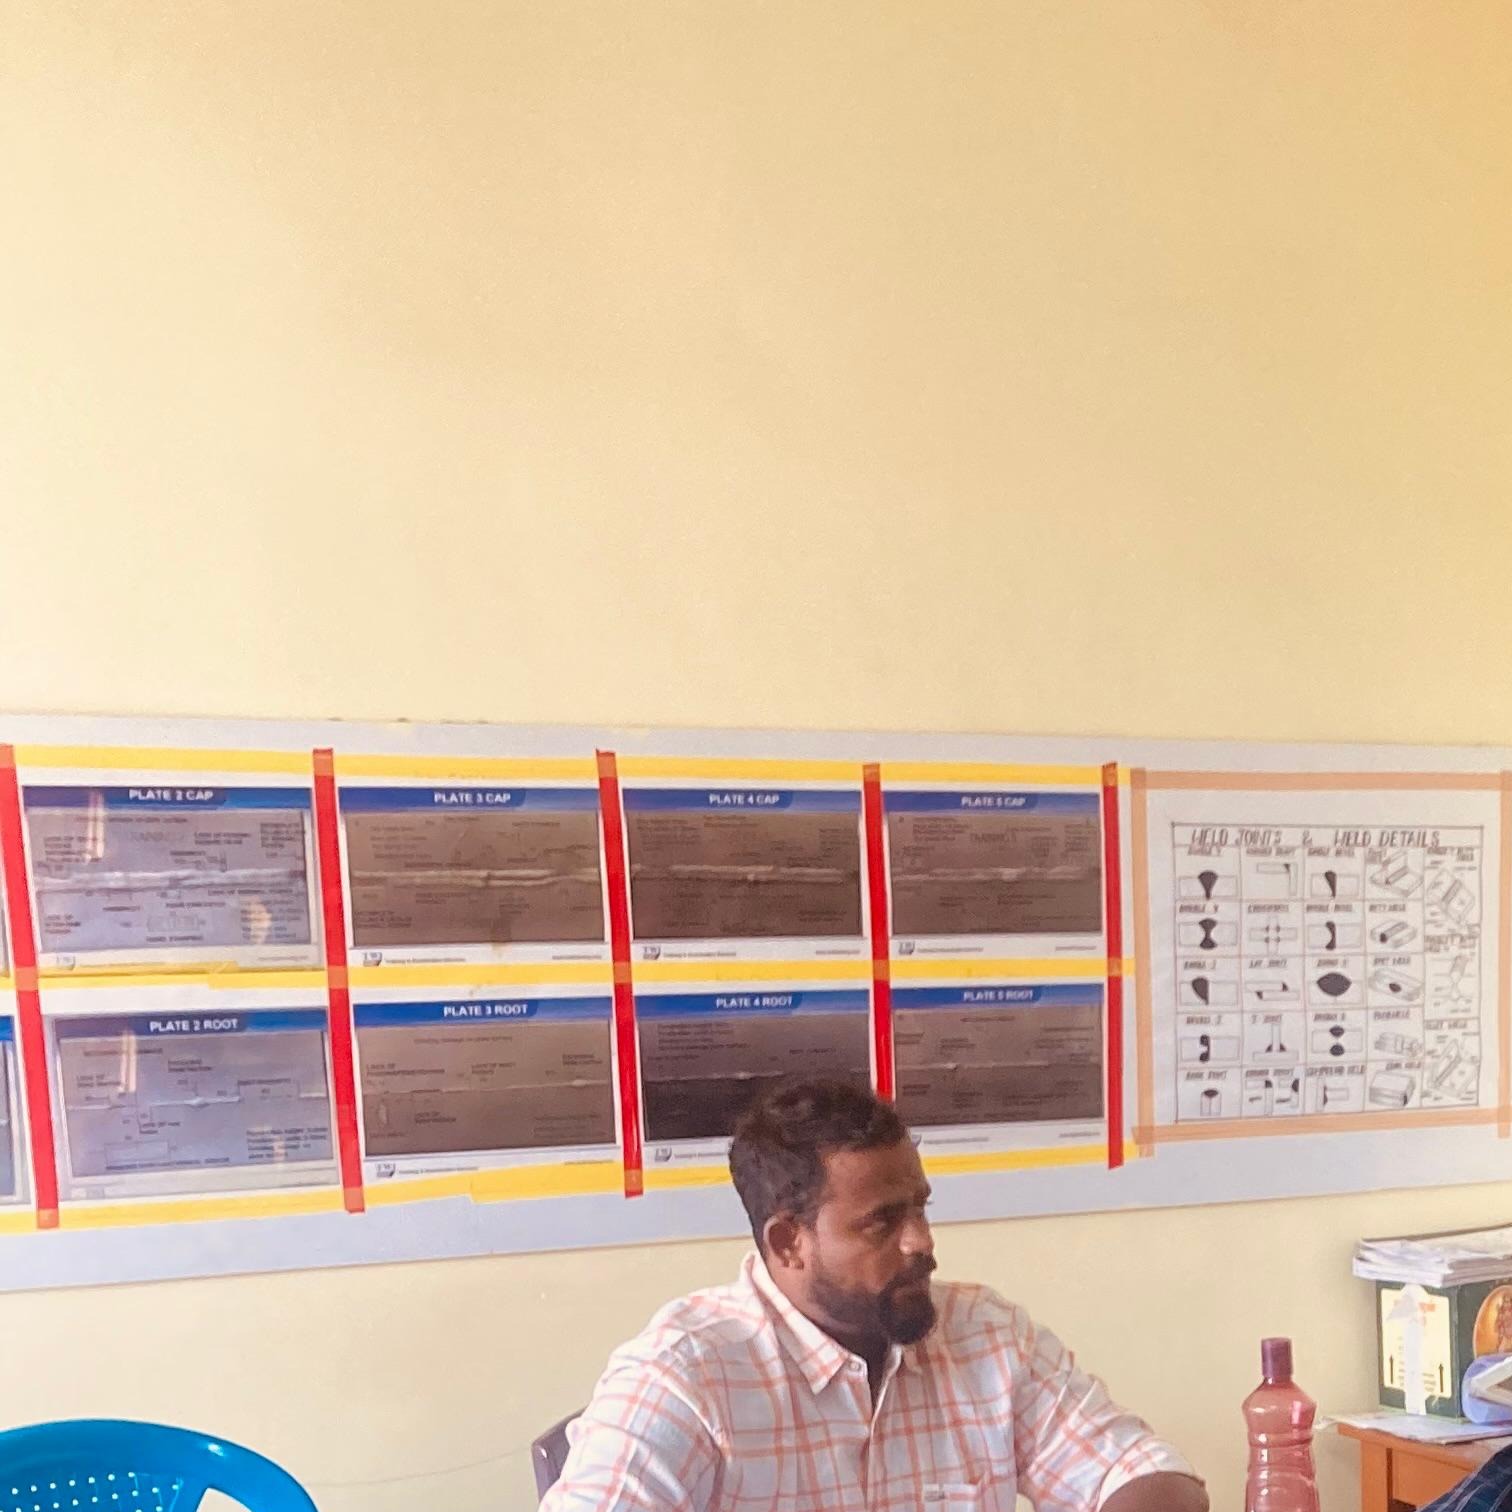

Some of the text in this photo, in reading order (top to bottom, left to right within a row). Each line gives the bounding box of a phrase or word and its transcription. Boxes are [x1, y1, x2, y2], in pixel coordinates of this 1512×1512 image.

[128, 789, 171, 801] PLATE
[185, 790, 214, 801] CAP
[434, 792, 474, 803] PLATE
[486, 792, 511, 804] CAP
[708, 793, 780, 805] PLATE 4 CAP
[961, 796, 995, 807] PLATE
[1334, 831, 1371, 848] WELD
[1378, 831, 1440, 848] DETAILS
[963, 990, 995, 1001] PLATE
[714, 997, 752, 1009] PLATE
[761, 995, 793, 1007] ROOT
[443, 1005, 483, 1017] PLATE
[494, 1003, 529, 1015] ROOT
[149, 1018, 239, 1032] PLATE 2 ROOT
